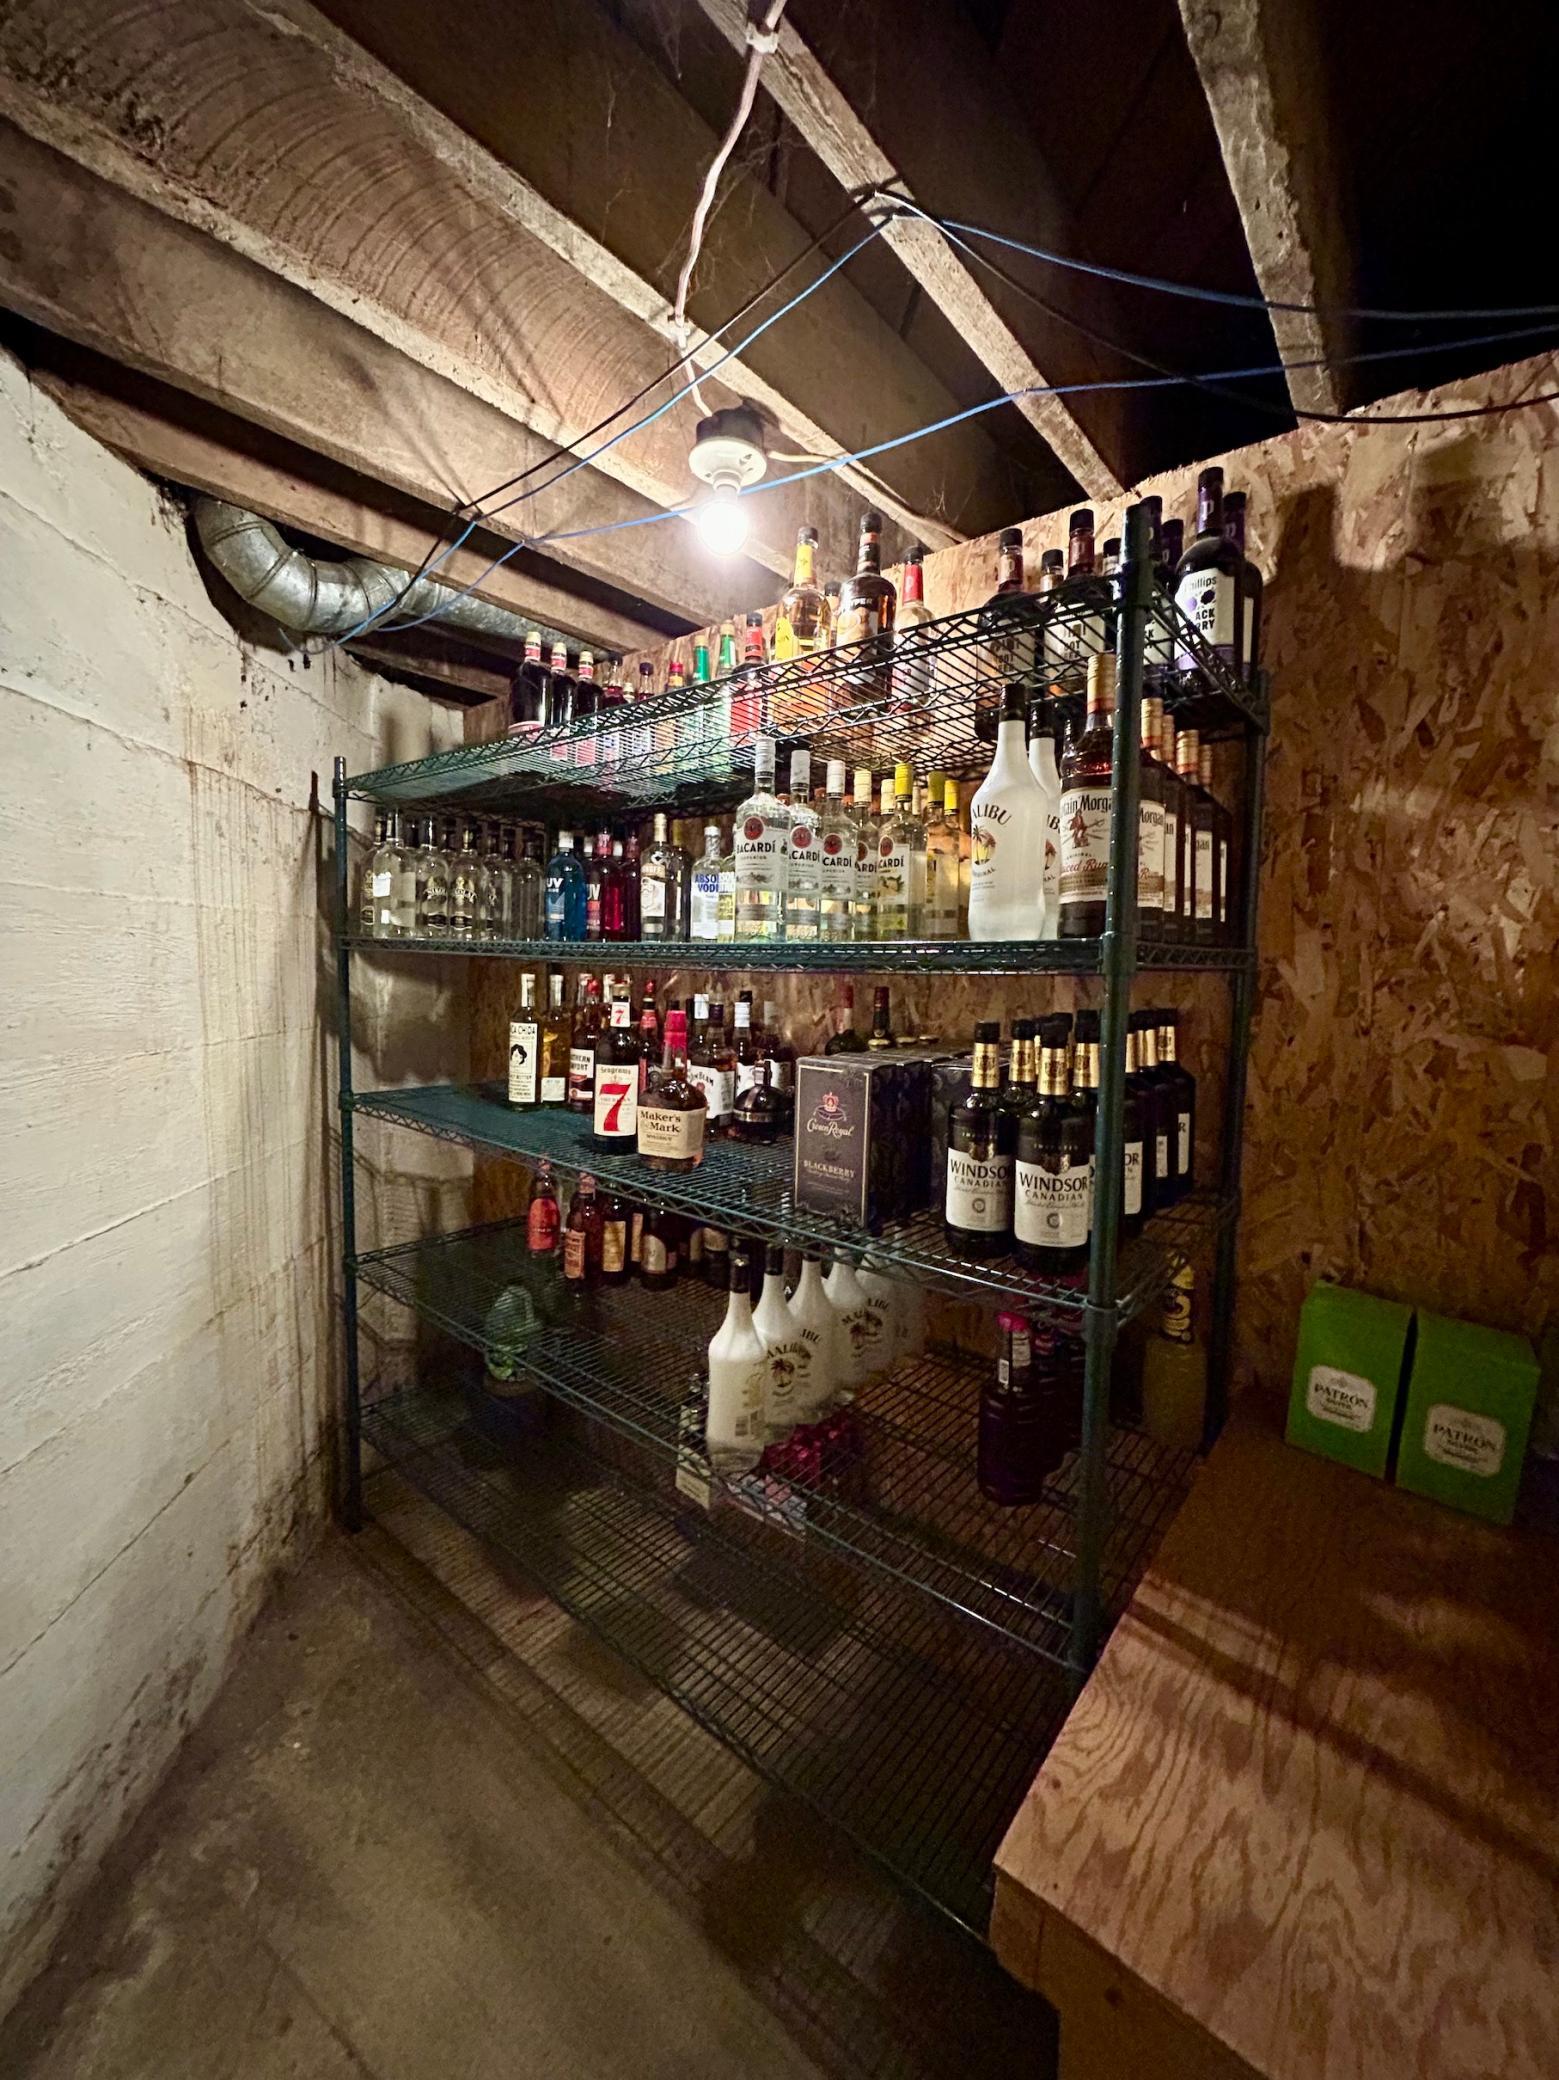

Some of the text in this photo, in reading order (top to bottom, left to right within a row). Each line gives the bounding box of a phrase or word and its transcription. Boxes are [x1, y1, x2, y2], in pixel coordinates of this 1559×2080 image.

[1184, 576, 1217, 593] hillips
[1079, 795, 1112, 814] Morg
[972, 803, 1012, 826] ALIBU
[788, 850, 820, 863] CARDÍ
[822, 855, 852, 868] CARDÍ
[546, 877, 564, 888] UV
[695, 873, 719, 883] ABSO
[614, 1008, 625, 1025] 7
[600, 1083, 632, 1132] 7
[640, 1110, 681, 1123] Maker's
[650, 1121, 681, 1133] Mark
[806, 1117, 855, 1139] Crown Royal
[803, 1159, 855, 1178] BLACKBERRY
[1019, 1171, 1089, 1193] WINDSOR
[1025, 1188, 1083, 1202] CANADIAN
